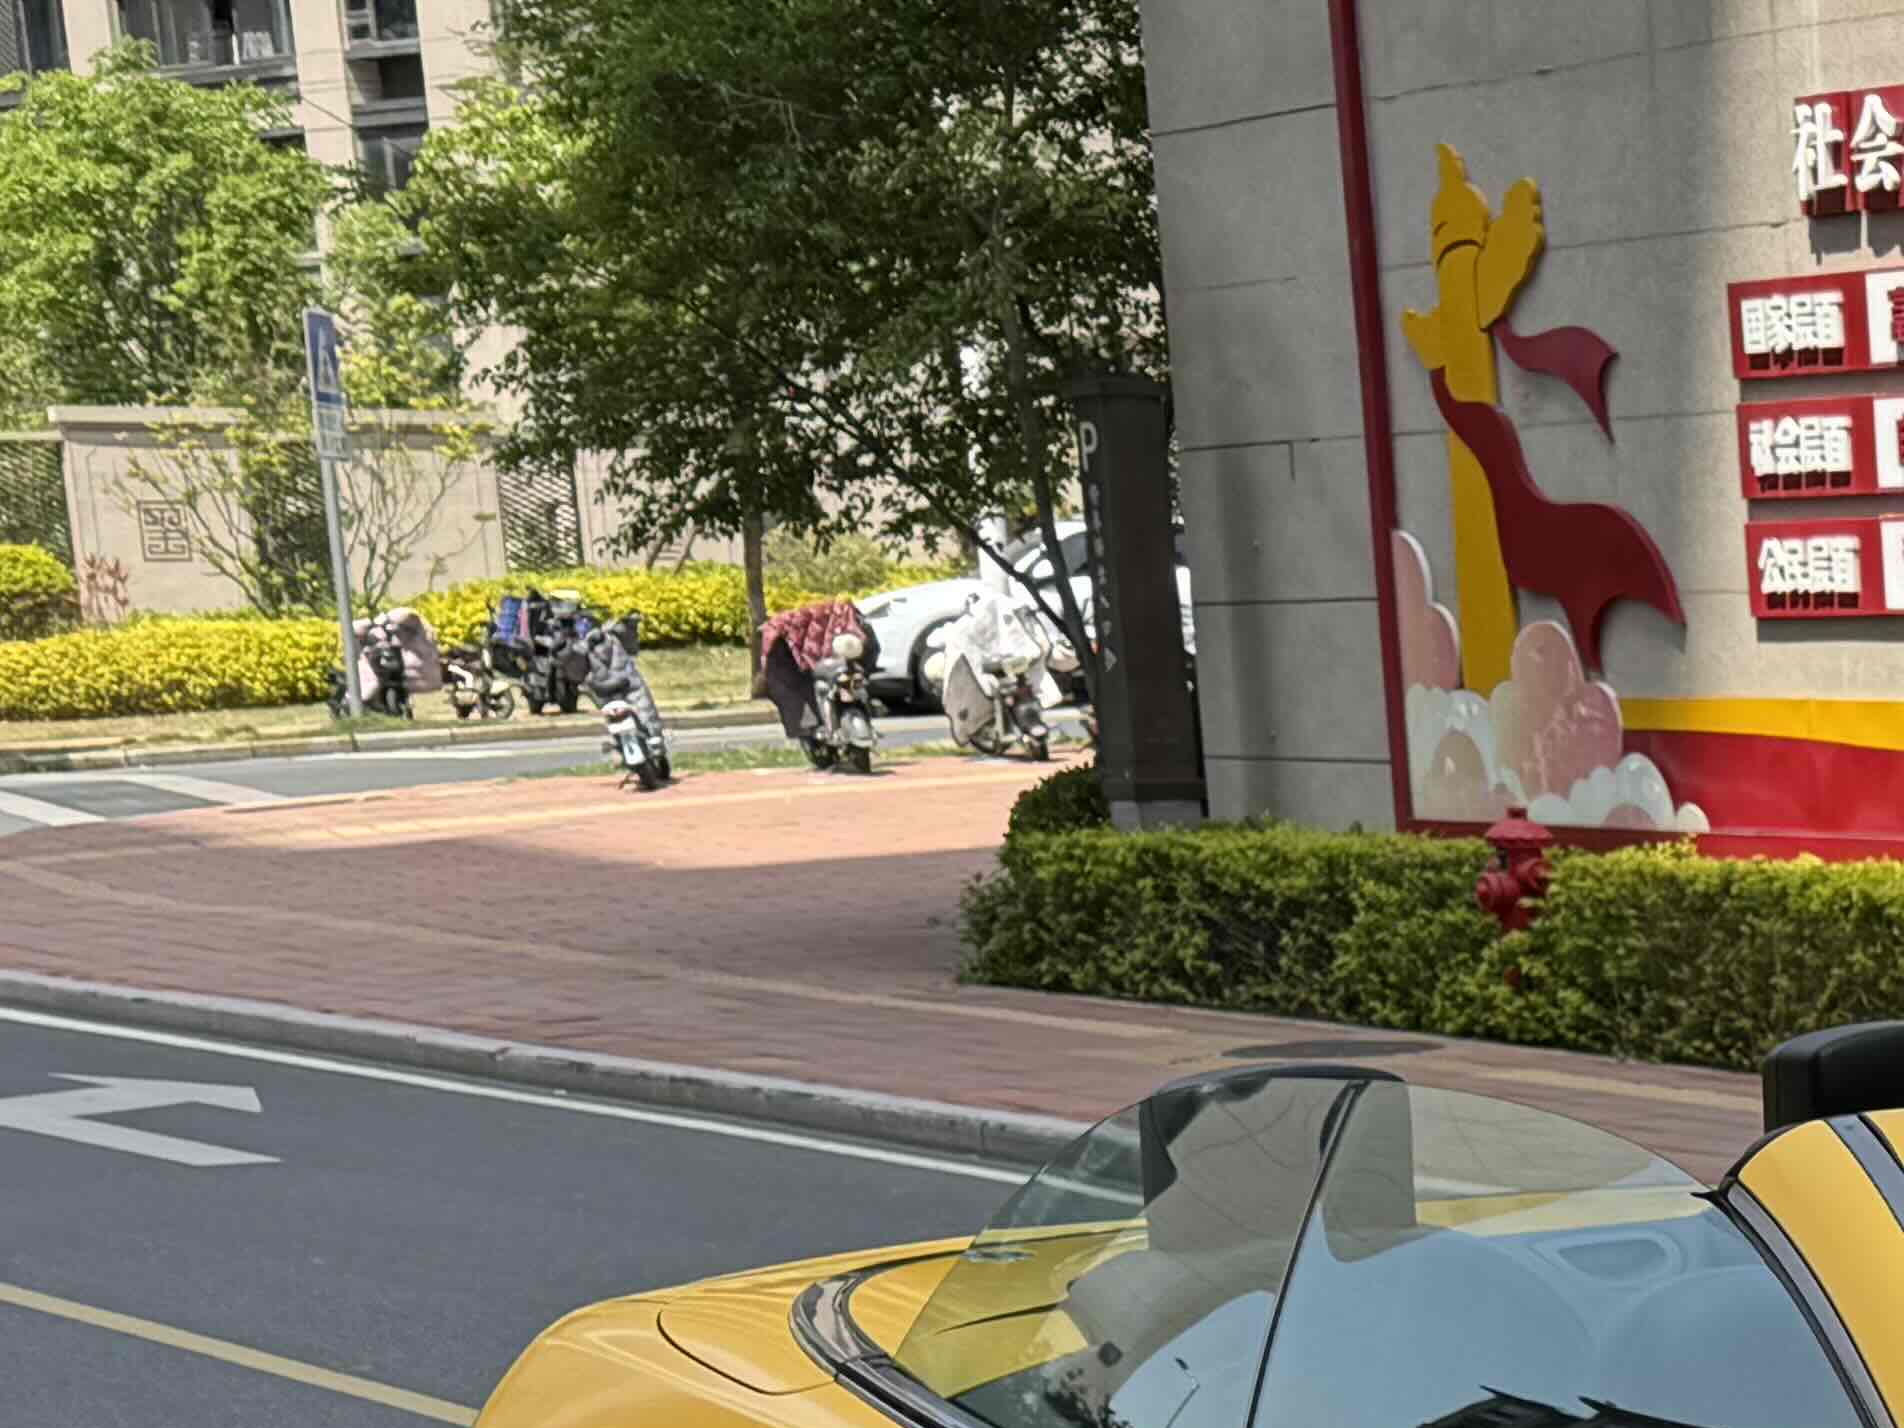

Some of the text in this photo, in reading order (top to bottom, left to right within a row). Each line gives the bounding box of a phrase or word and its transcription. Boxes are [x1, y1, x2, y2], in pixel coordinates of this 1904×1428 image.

[1740, 289, 1847, 355] 国家层面
[1079, 421, 1098, 472] P
[1748, 415, 1854, 477] 社会层面
[1757, 536, 1862, 595] 公民层面
